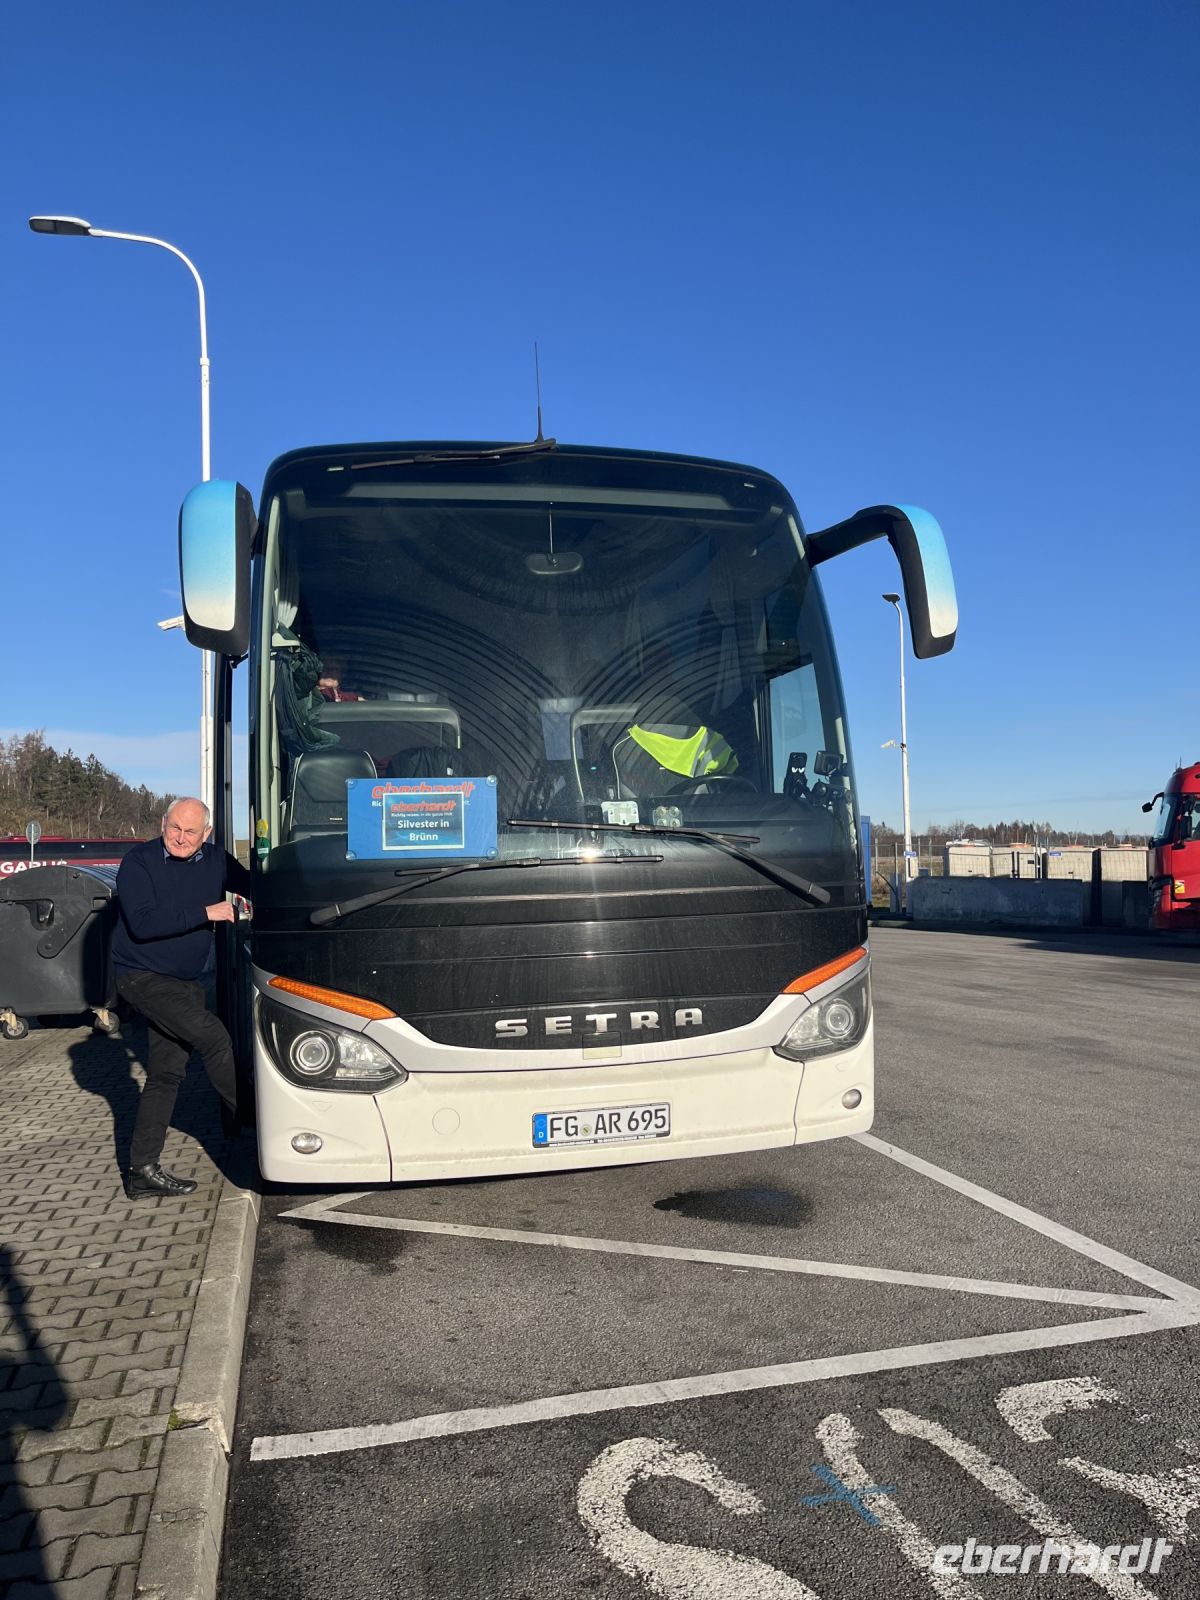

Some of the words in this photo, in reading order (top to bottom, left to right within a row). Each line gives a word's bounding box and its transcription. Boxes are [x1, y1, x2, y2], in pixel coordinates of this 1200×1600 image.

[391, 800, 456, 813] eberhardt
[397, 820, 439, 829] Silvester
[440, 819, 450, 828] in
[409, 832, 439, 841] Brünn
[495, 1007, 703, 1038] SETRA
[550, 1115, 579, 1138] FG
[594, 1112, 622, 1135] AR
[627, 1108, 667, 1132] 695
